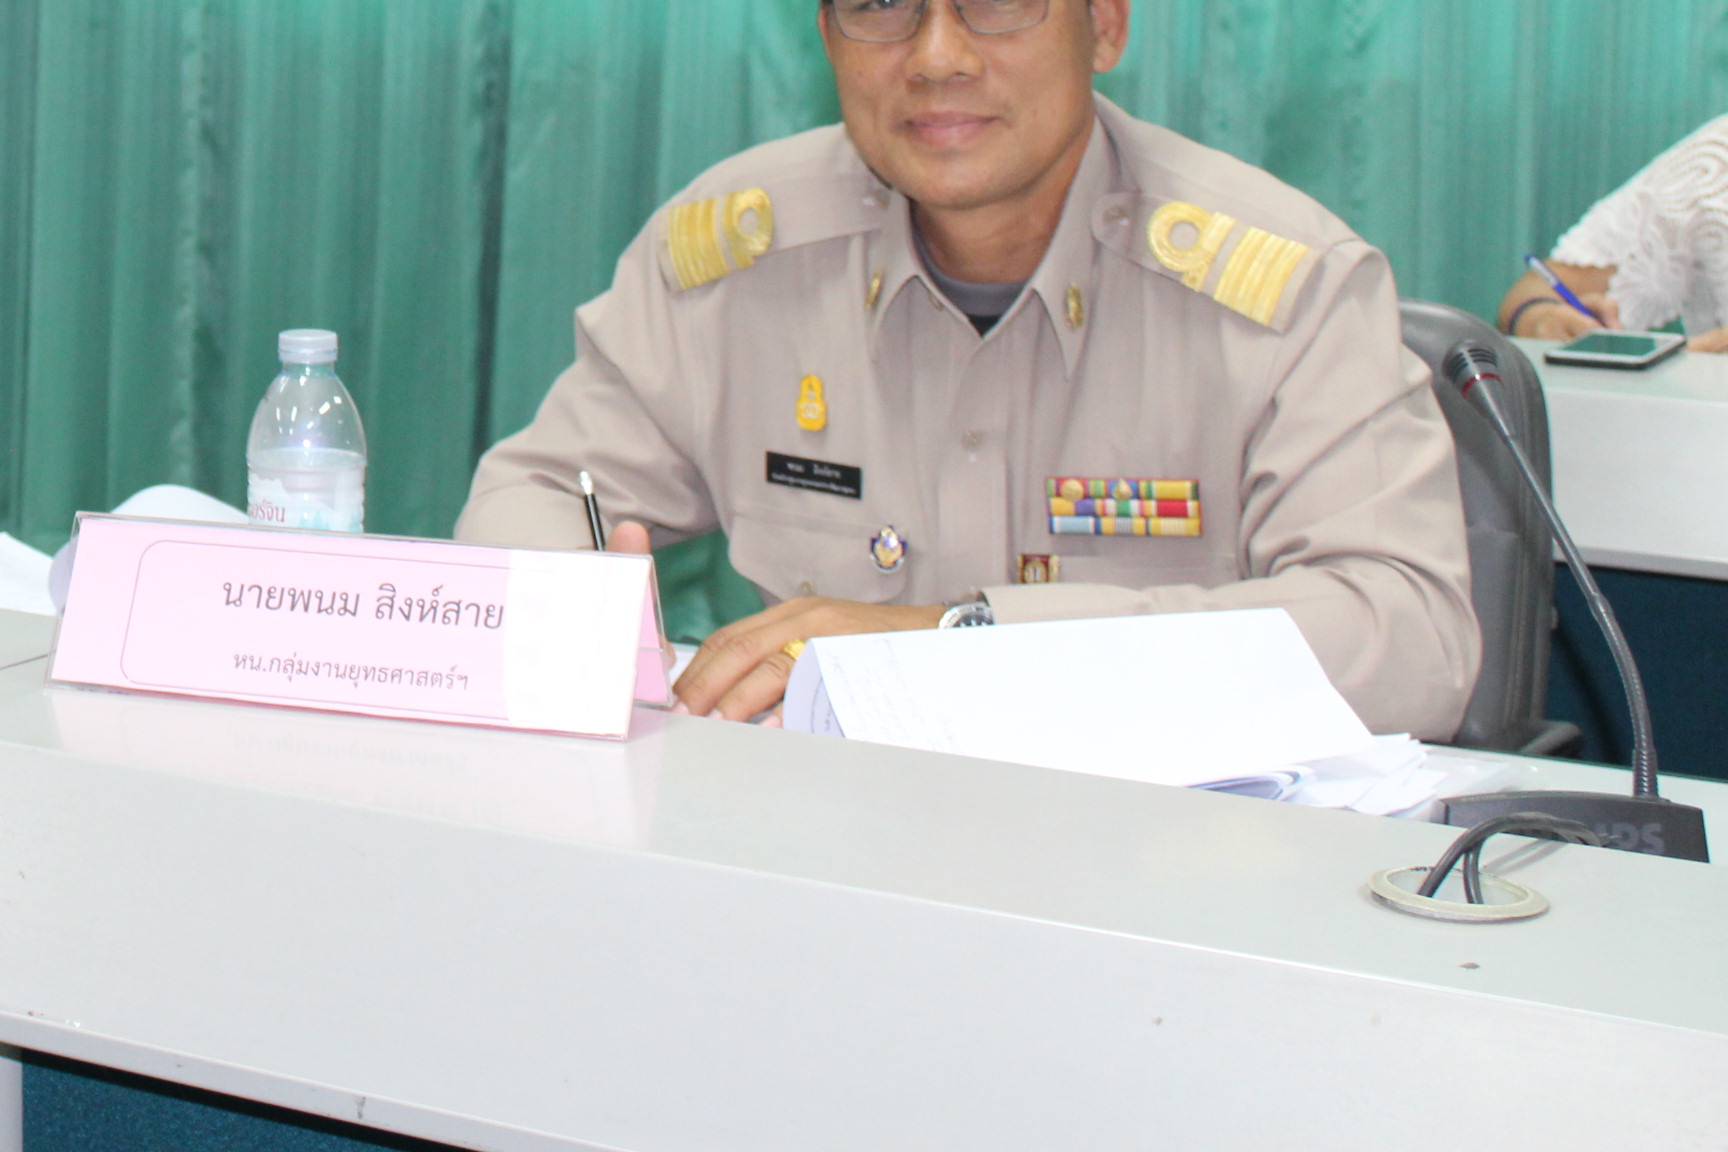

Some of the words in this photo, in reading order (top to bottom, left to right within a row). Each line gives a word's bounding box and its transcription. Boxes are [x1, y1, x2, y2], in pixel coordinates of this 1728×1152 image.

[222, 580, 361, 618] นายพนม
[374, 582, 505, 630] สิงห์สาย
[233, 652, 470, 690] หน.กลุ่มงานยุทธศาสตร์ฯ
